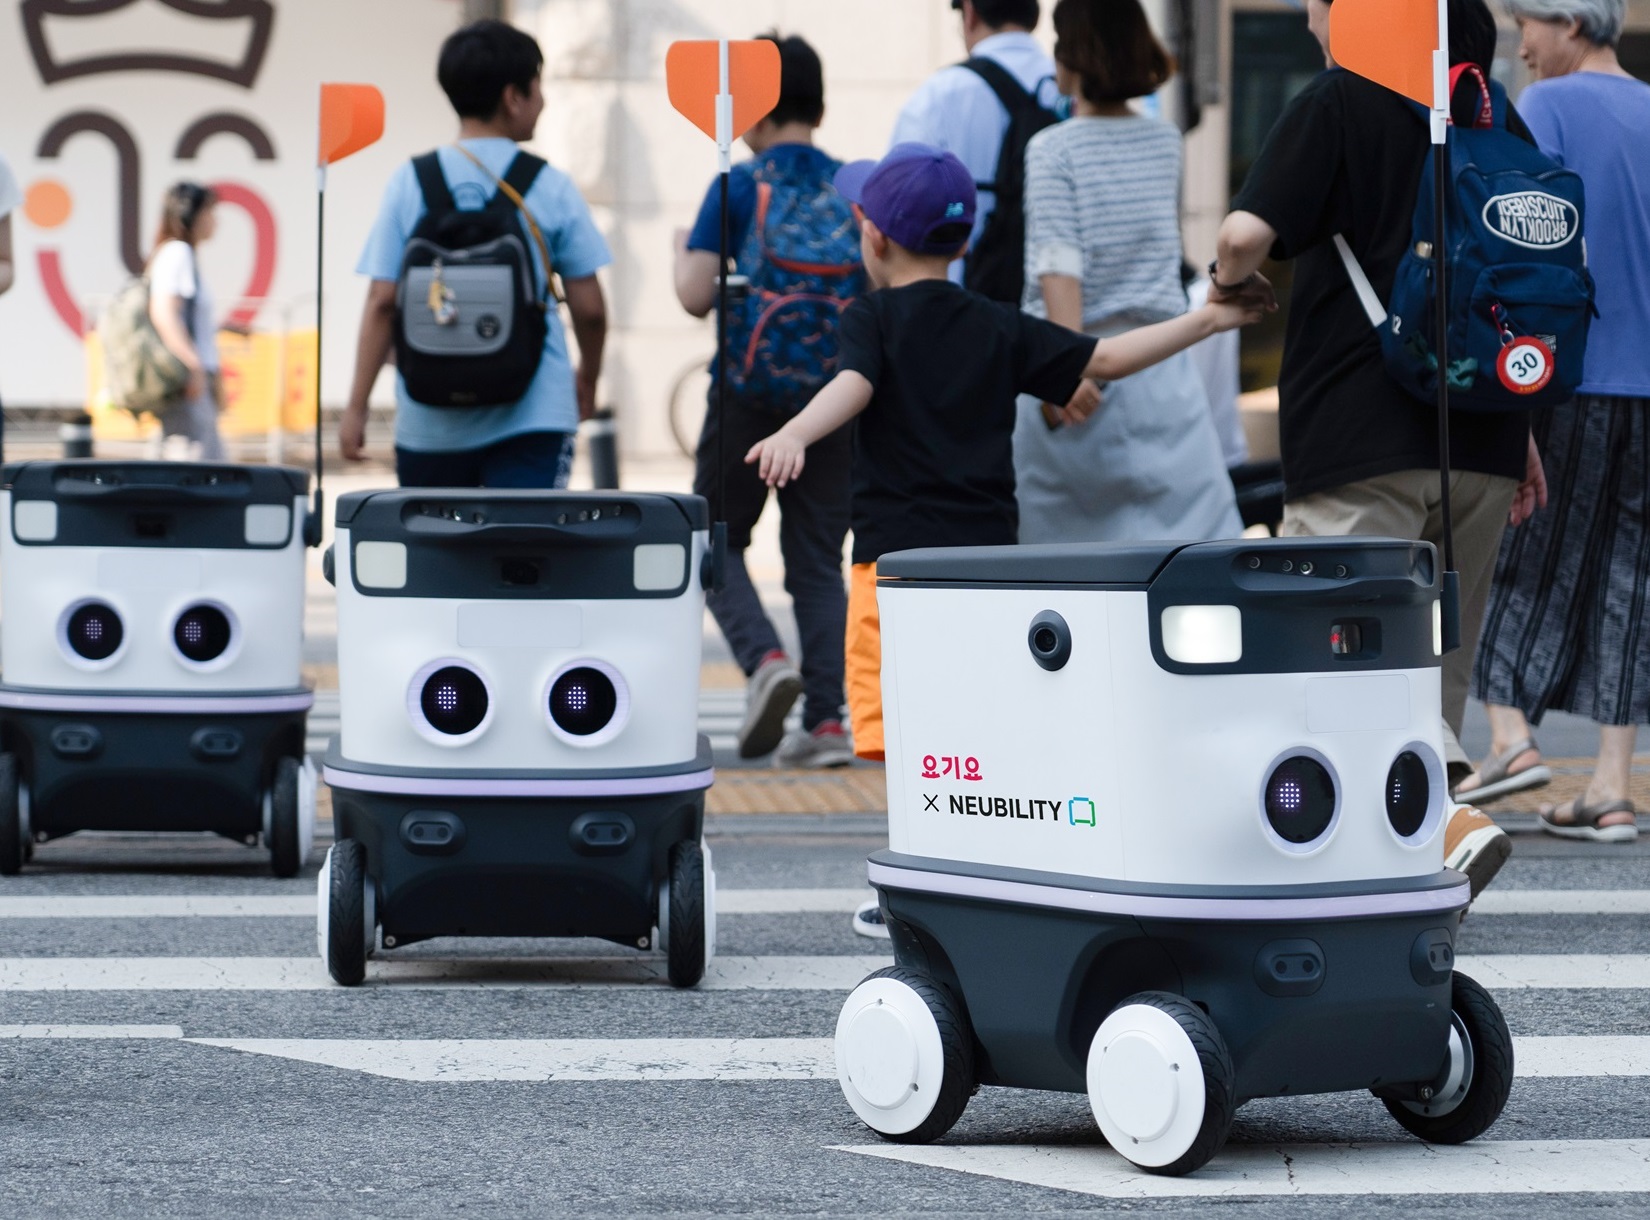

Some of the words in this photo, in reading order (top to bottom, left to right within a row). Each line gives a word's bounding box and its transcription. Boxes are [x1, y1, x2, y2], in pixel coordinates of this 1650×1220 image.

[1497, 195, 1566, 220] ICEBISCUIT
[1500, 215, 1568, 243] BROOKLYN
[1511, 352, 1538, 378] 30
[921, 754, 983, 781] 요기요
[949, 794, 1062, 821] NEUBILITY
